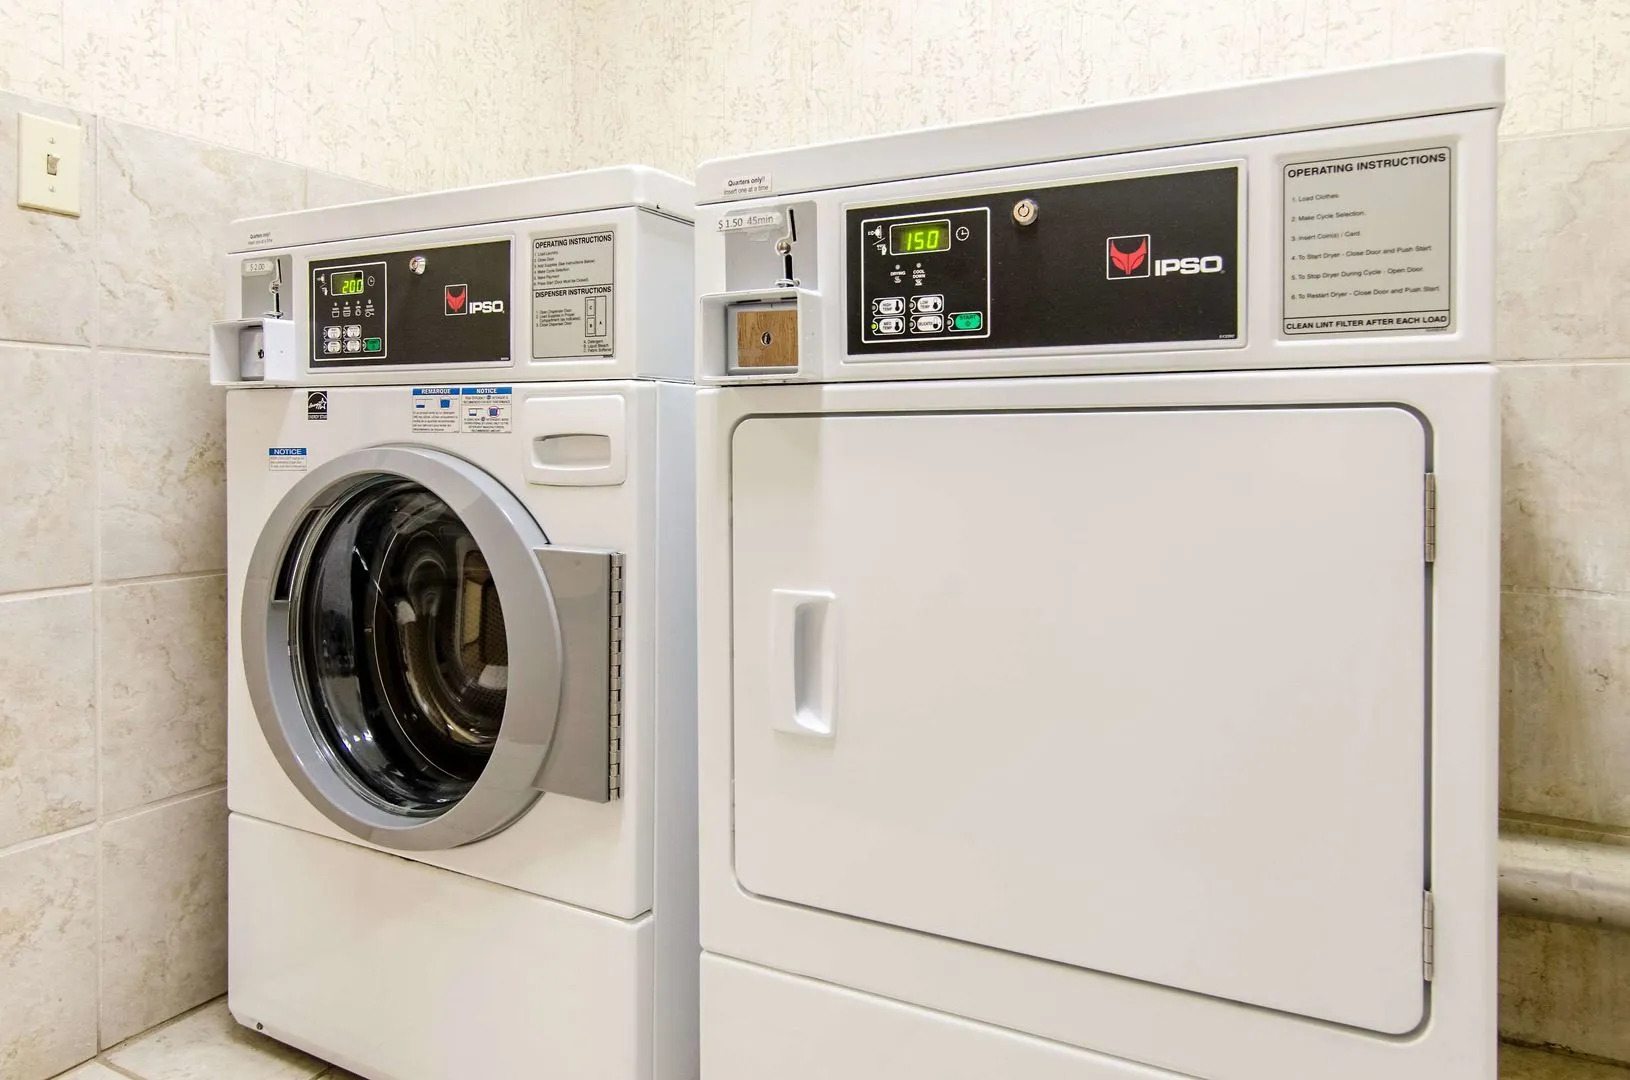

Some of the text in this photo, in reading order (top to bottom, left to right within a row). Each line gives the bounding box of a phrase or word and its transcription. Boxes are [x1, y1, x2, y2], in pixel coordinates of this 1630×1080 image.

[1288, 153, 1446, 178] OPERATING INSTRUCTIONS
[728, 179, 750, 187] Quarters
[726, 218, 743, 227] 1.50
[747, 215, 773, 225] 45min
[535, 234, 612, 249] OPERATING INSTRUCTIONS
[907, 230, 939, 251] 150
[1155, 255, 1222, 276] IPSO
[342, 279, 363, 294] 200
[535, 286, 612, 298] DISPENSER INSTRUCTIONS
[469, 300, 504, 314] IPSO
[1286, 322, 1313, 330] CLEAN
[1336, 319, 1364, 327] FILTER
[1366, 318, 1394, 326] AFTER
[1422, 315, 1447, 323] LOAD
